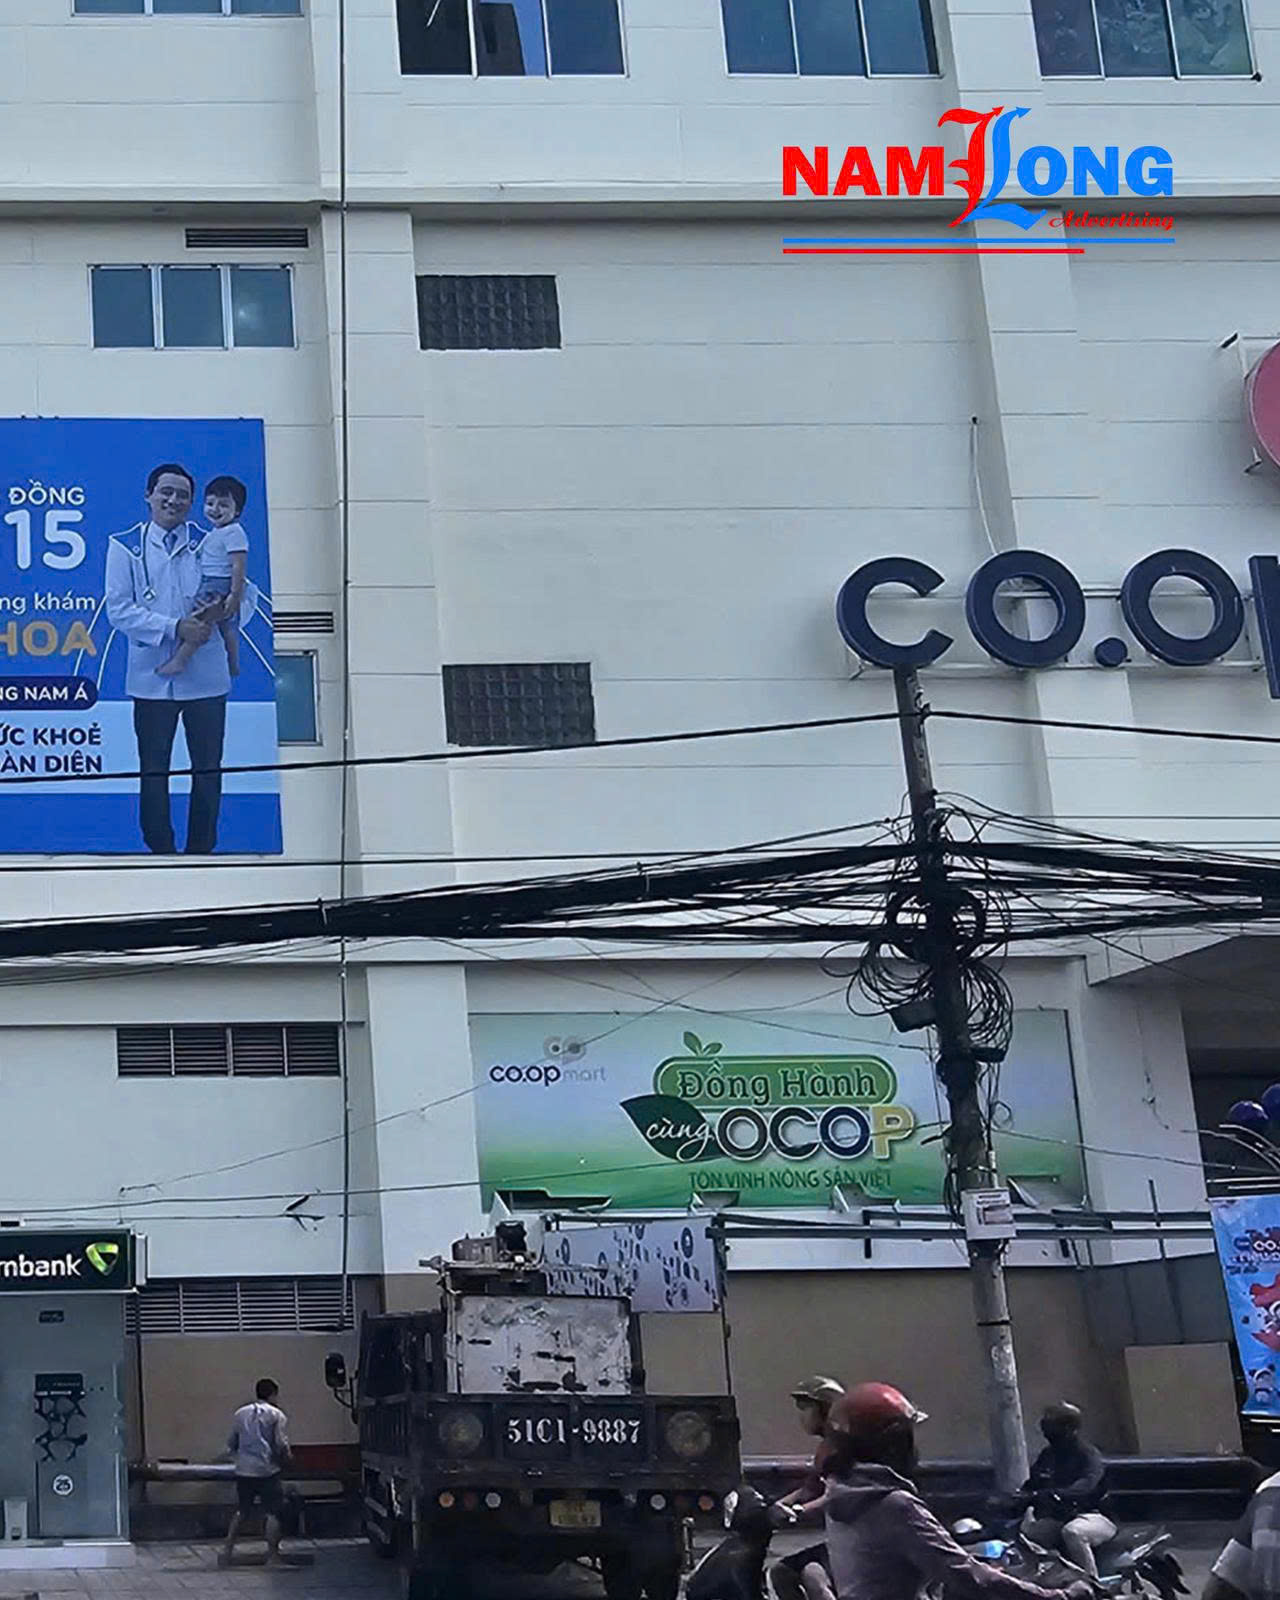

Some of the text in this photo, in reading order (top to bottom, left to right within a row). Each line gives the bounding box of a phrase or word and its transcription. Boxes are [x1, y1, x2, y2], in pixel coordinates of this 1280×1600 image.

[9, 479, 85, 505] ĐỒNG
[34, 591, 96, 611] khám
[24, 686, 68, 701] NAM
[74, 682, 88, 701] Á
[33, 722, 102, 746] KHOẺ
[45, 750, 103, 776] DIỆN
[678, 1058, 878, 1106] Đồng Hành
[645, 1104, 915, 1163] cùng OCOP
[725, 1170, 765, 1188] VINH
[770, 1166, 820, 1188] NÔNG
[508, 1418, 640, 1443] 51C1-9887
